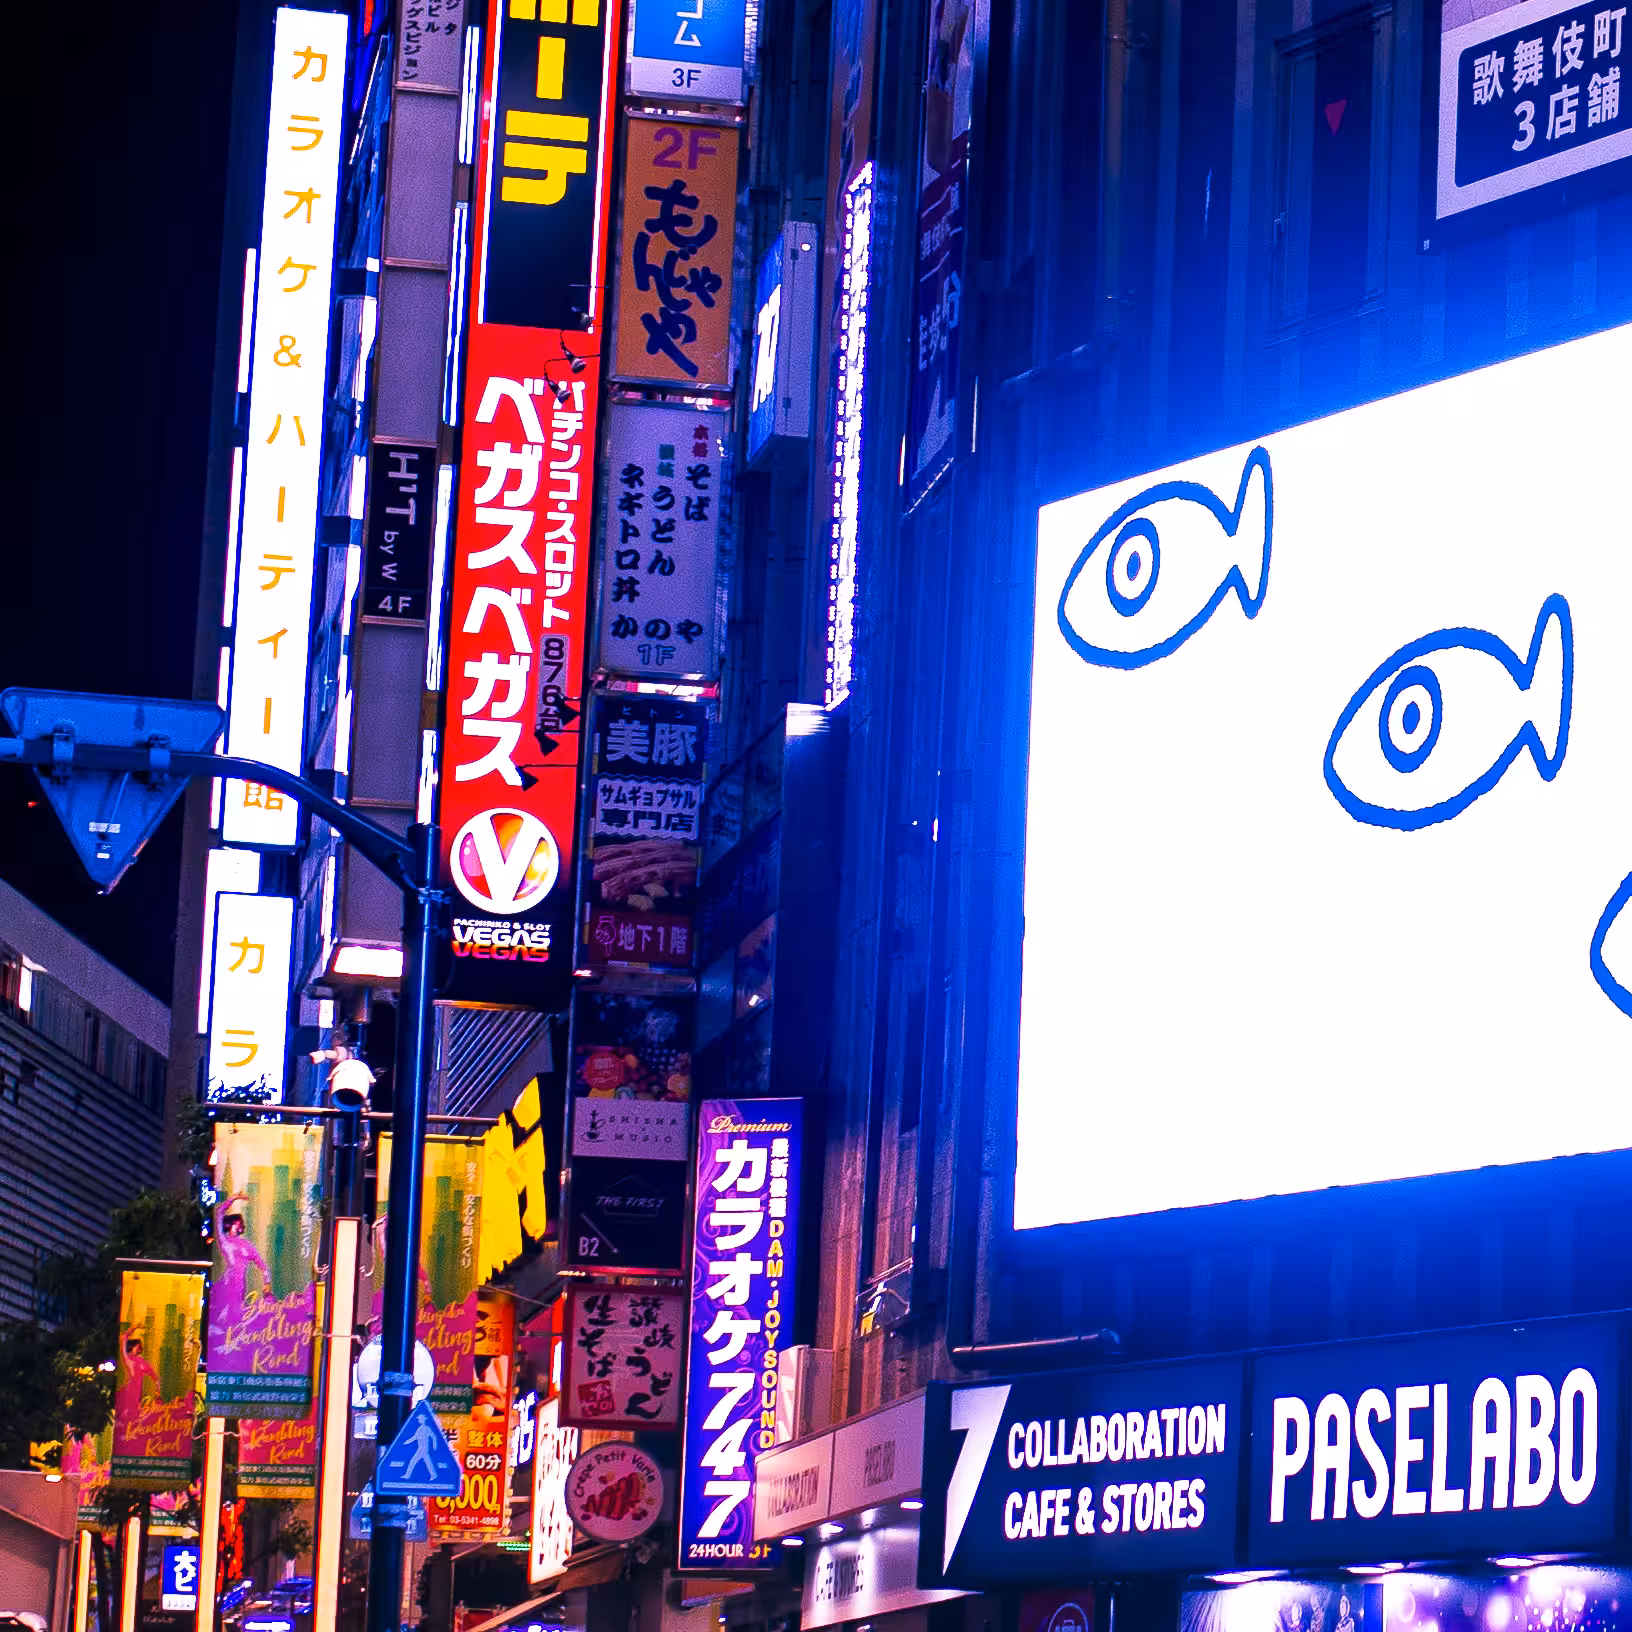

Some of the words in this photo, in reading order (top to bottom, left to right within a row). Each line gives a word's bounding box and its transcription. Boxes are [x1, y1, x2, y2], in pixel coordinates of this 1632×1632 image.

[671, 67, 702, 89] 3F
[1511, 65, 1622, 152] 3店舗
[652, 127, 721, 169] 2F
[380, 530, 399, 555] by
[611, 463, 645, 604] ネギトロ丼
[381, 563, 398, 581] W
[455, 374, 546, 787] ベガスベガス
[378, 595, 412, 613] 4F
[610, 613, 704, 644] かのや
[636, 644, 677, 666] 1F
[605, 719, 697, 766] 美豚
[600, 811, 696, 833] 専門店
[452, 925, 551, 948] VEGAS
[524, 922, 552, 931] SLOT
[707, 1114, 792, 1135] Premium
[578, 1236, 600, 1257] B2
[704, 1139, 769, 1367] カラオケ
[467, 1430, 503, 1449] 整体
[1006, 1402, 1227, 1470] COLLABORATION
[1269, 1367, 1599, 1524] PASELABO
[465, 1454, 502, 1470] 60分
[697, 1371, 756, 1538] 747
[1003, 1487, 1071, 1541] CAFE
[1073, 1485, 1096, 1533] &
[1100, 1478, 1206, 1535] STORES
[688, 1542, 744, 1560] 24HOUR
